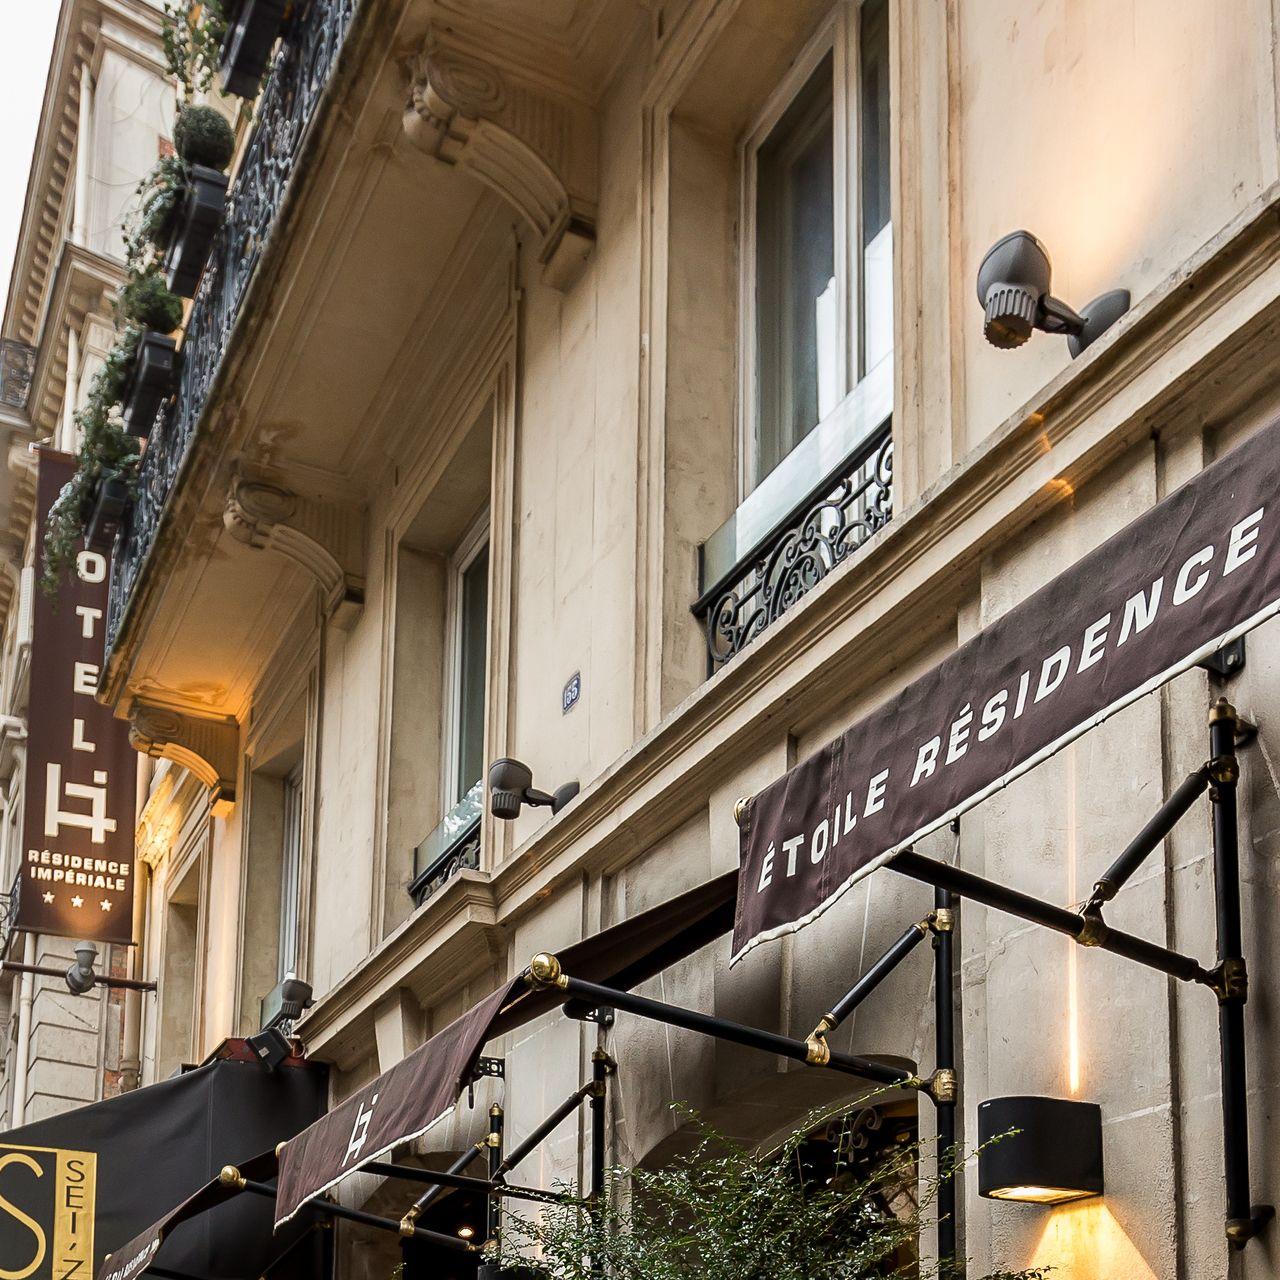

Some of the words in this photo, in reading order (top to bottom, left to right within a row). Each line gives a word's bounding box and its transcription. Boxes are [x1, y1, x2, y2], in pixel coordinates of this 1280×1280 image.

[72, 550, 107, 753] OTEL
[757, 768, 890, 894] ÉTOILE
[909, 506, 1265, 788] RÉSIDENCE
[28, 849, 130, 876] RÉSIDENCE
[30, 866, 126, 891] IMPÉRIALE
